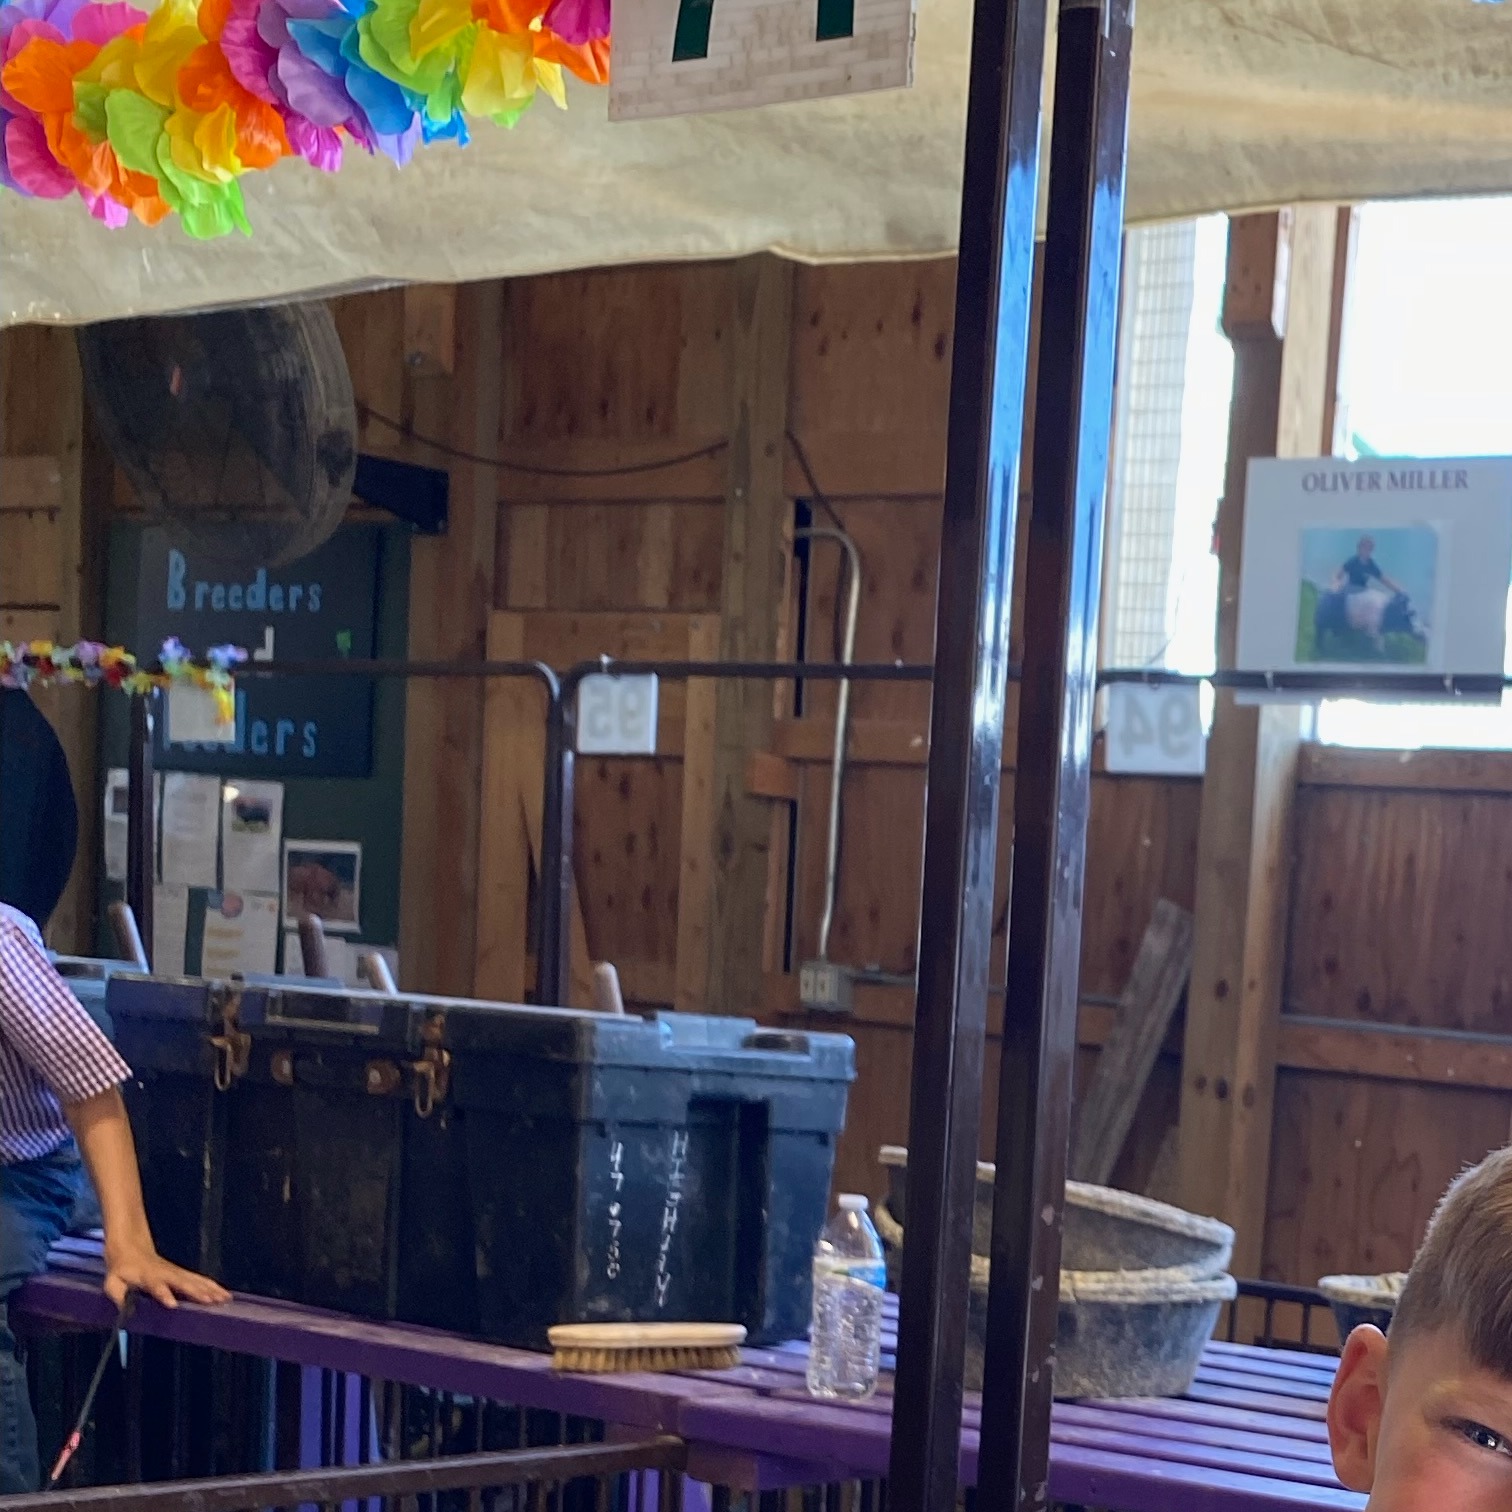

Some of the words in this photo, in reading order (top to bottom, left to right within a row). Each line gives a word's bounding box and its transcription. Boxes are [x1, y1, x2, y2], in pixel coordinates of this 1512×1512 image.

[1301, 471, 1382, 492] OLIVER
[1386, 469, 1469, 490] MILLER
[167, 549, 323, 612] Breeders
